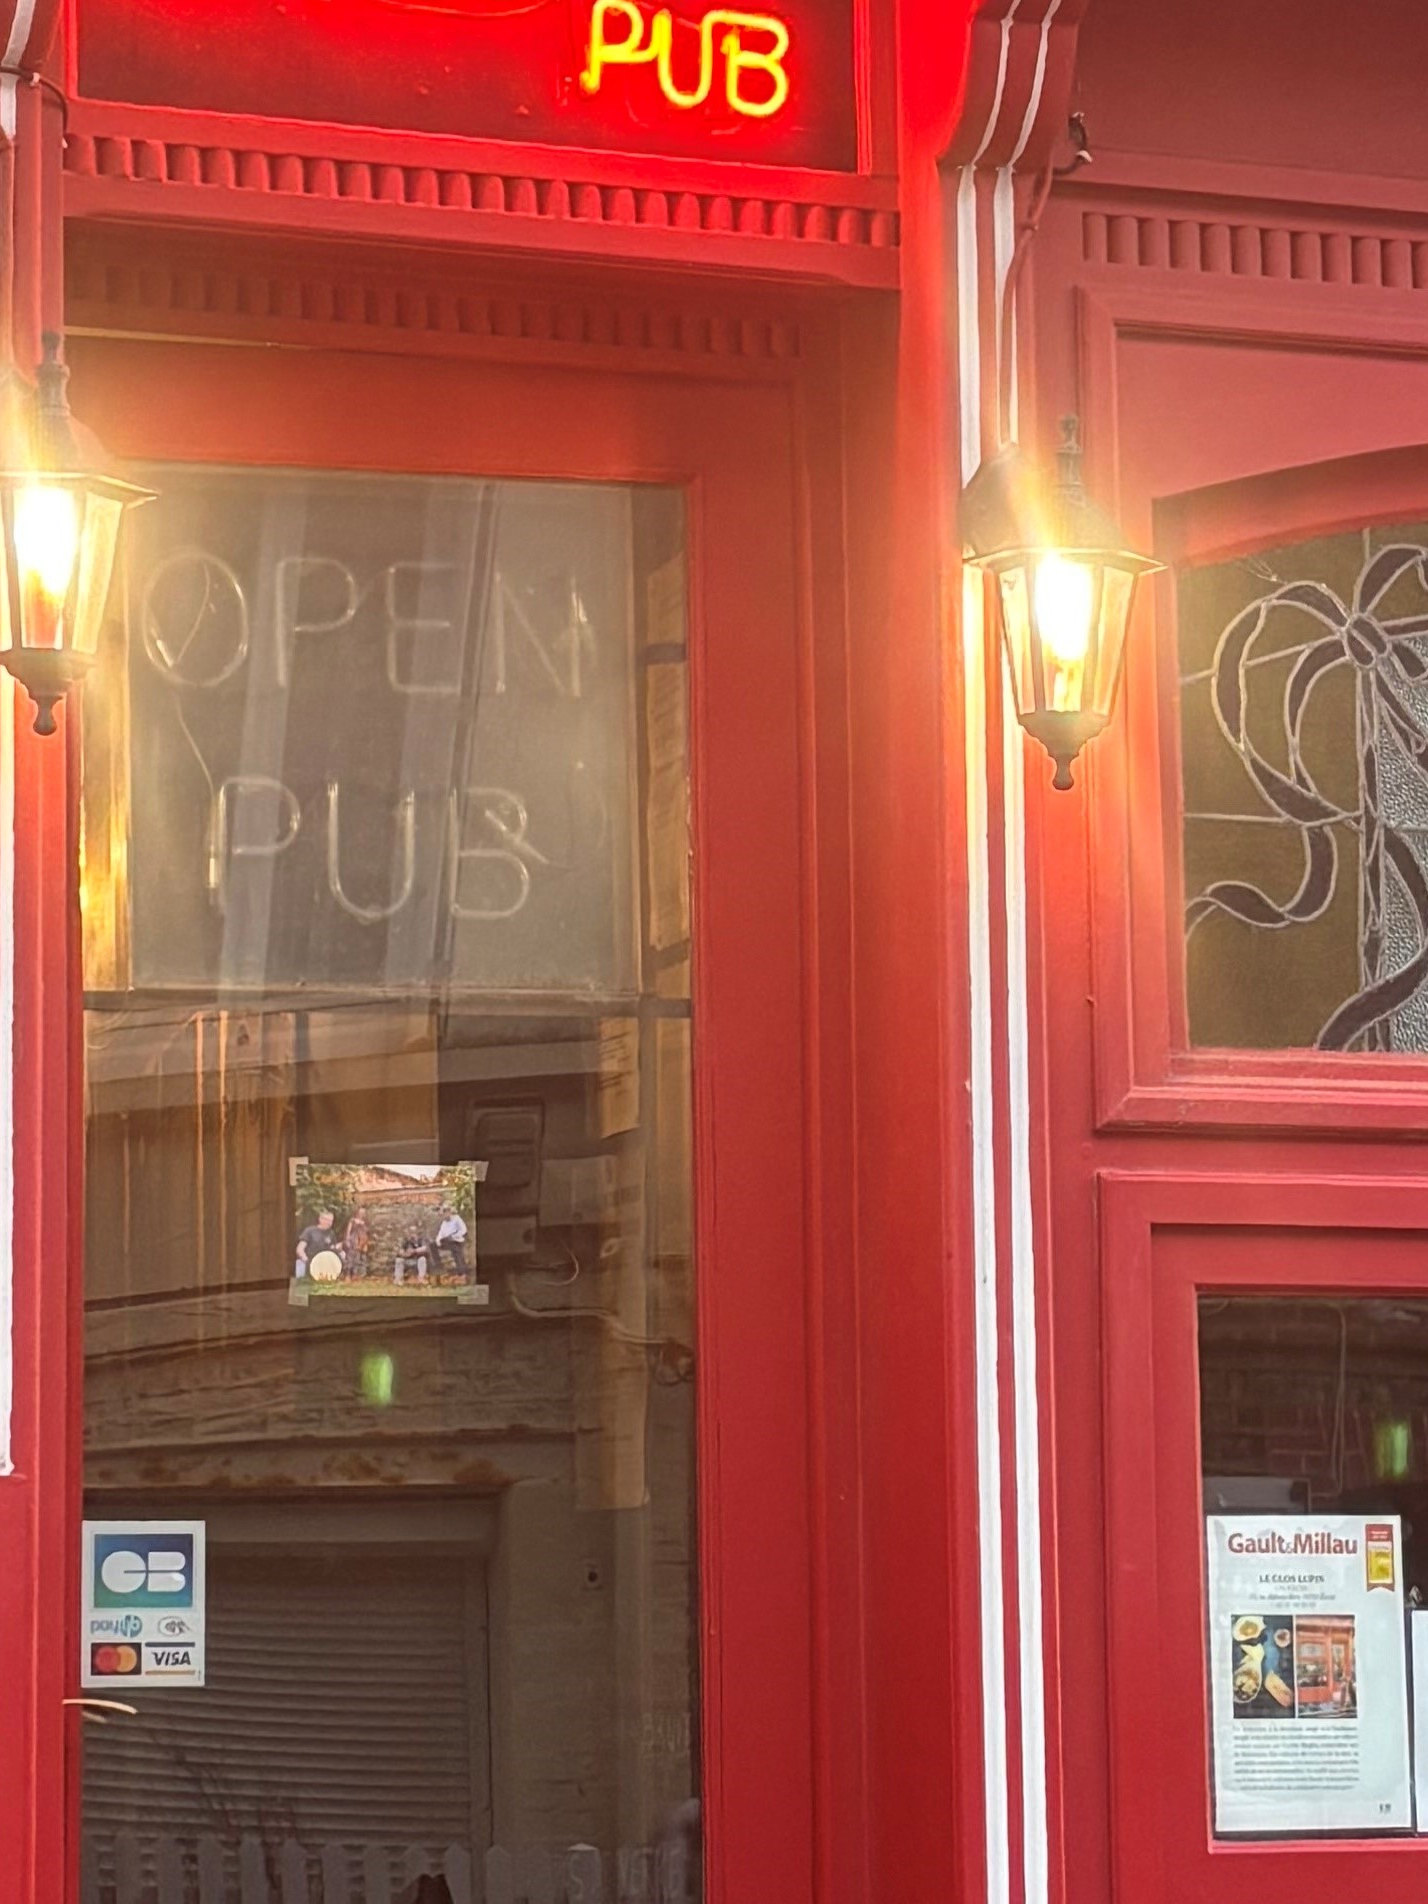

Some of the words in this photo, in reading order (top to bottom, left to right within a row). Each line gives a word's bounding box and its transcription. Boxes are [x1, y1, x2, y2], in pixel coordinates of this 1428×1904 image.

[143, 549, 584, 698] OPEN
[210, 775, 544, 924] PUB
[101, 1550, 186, 1594] CB
[152, 1651, 191, 1666] VISA
